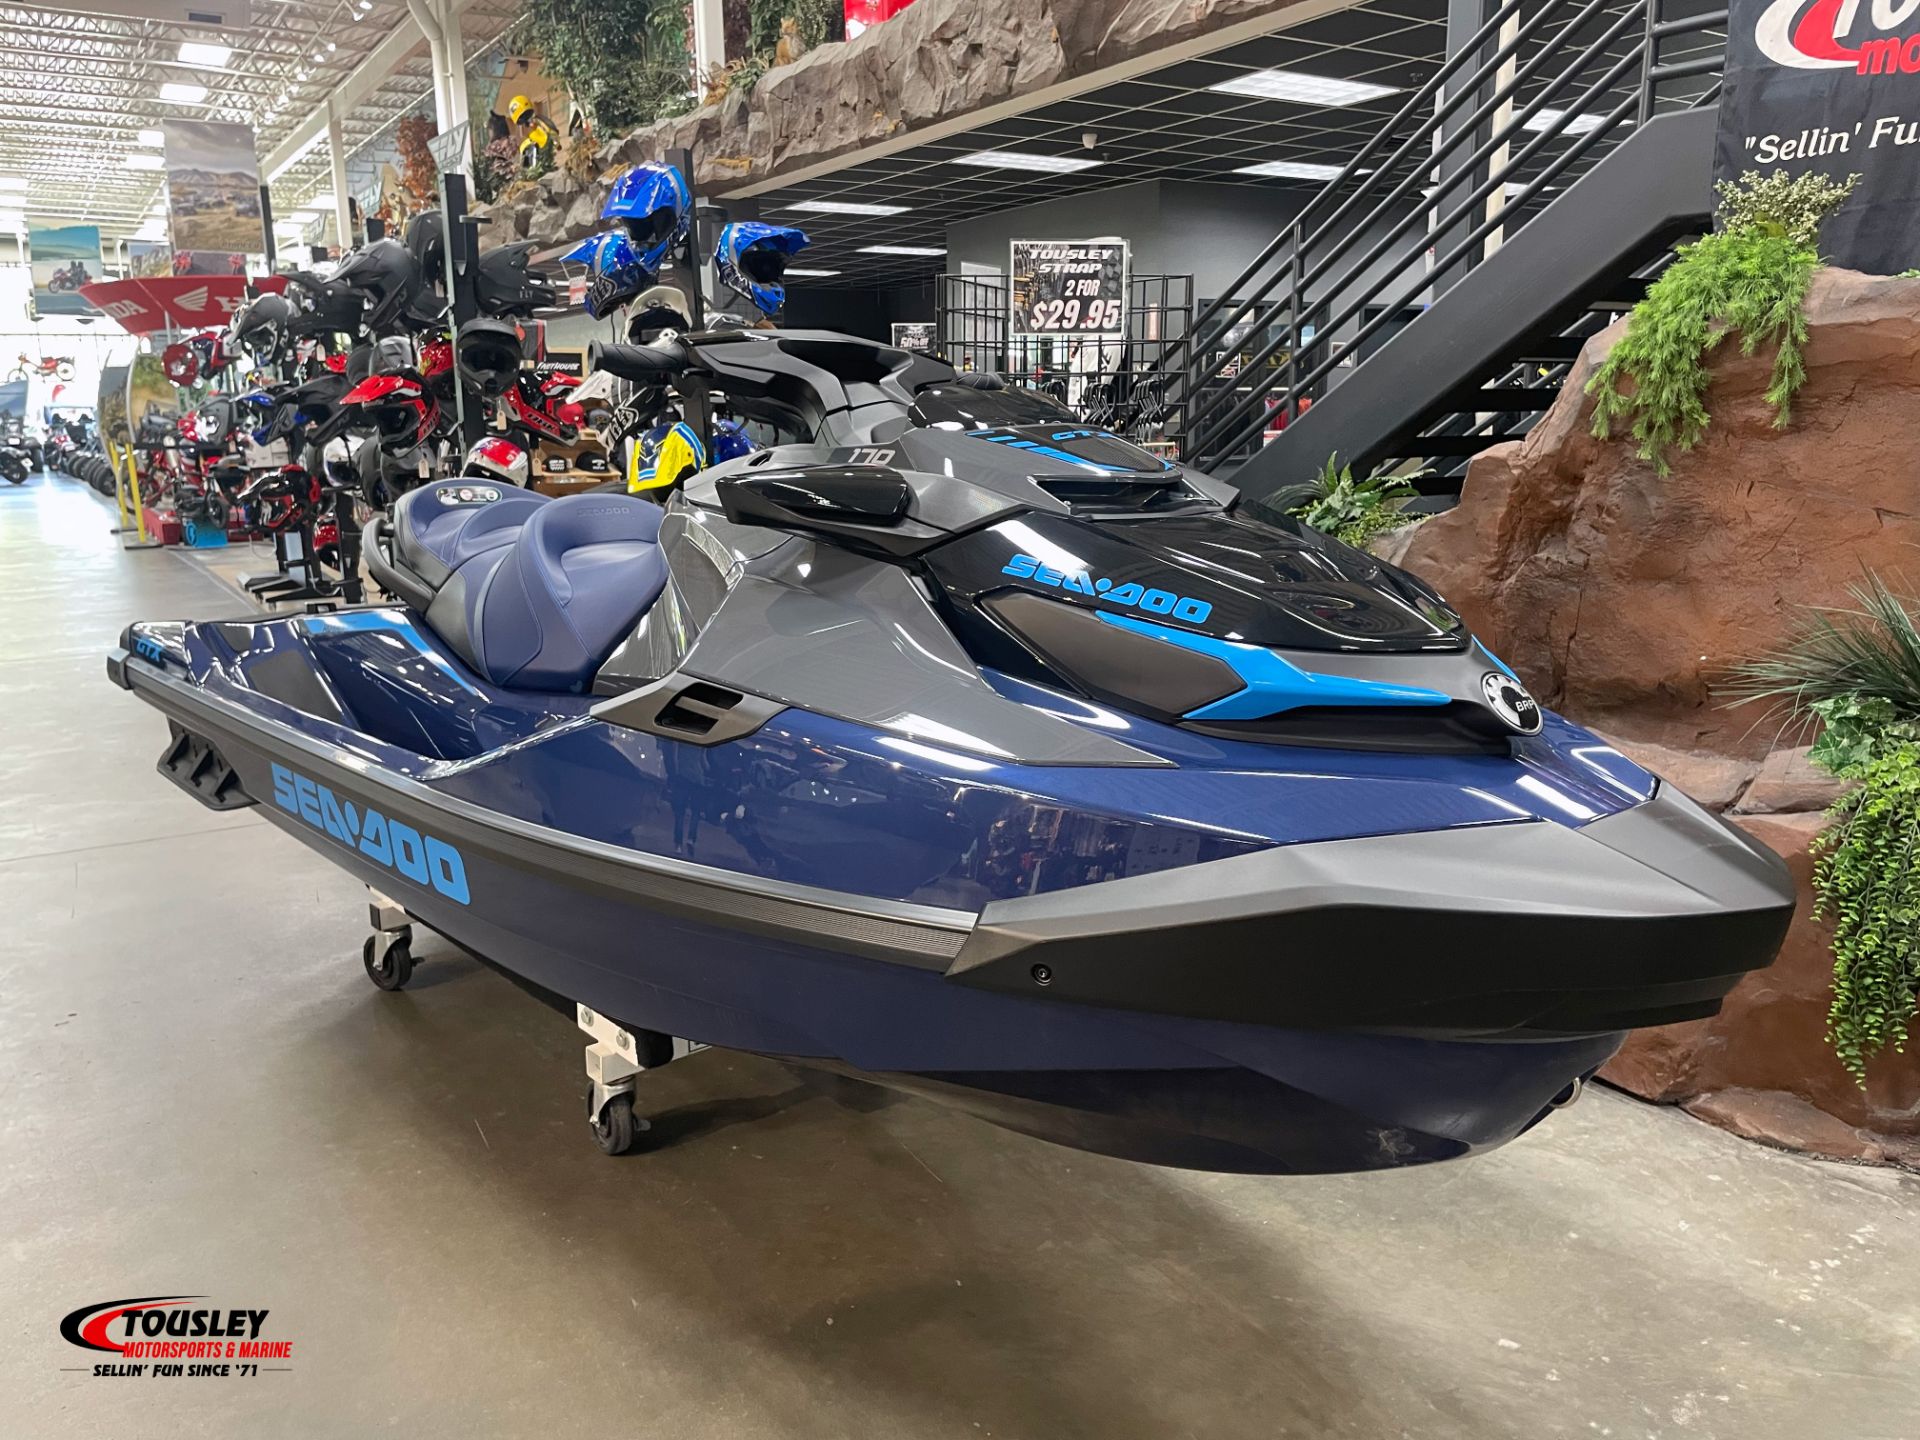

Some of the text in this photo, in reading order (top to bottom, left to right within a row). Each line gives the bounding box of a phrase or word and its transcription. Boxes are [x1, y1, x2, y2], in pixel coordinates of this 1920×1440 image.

[1868, 116, 1920, 149] Fu
[1029, 249, 1114, 260] TOUSLEY
[1037, 263, 1103, 274] STRAP
[1064, 279, 1101, 297] 2 FOR
[1030, 299, 1122, 331] $29.95
[537, 361, 581, 371] FASTHOUSE
[848, 448, 896, 465] 170
[136, 636, 165, 663] GTX
[1515, 699, 1535, 712] BRP
